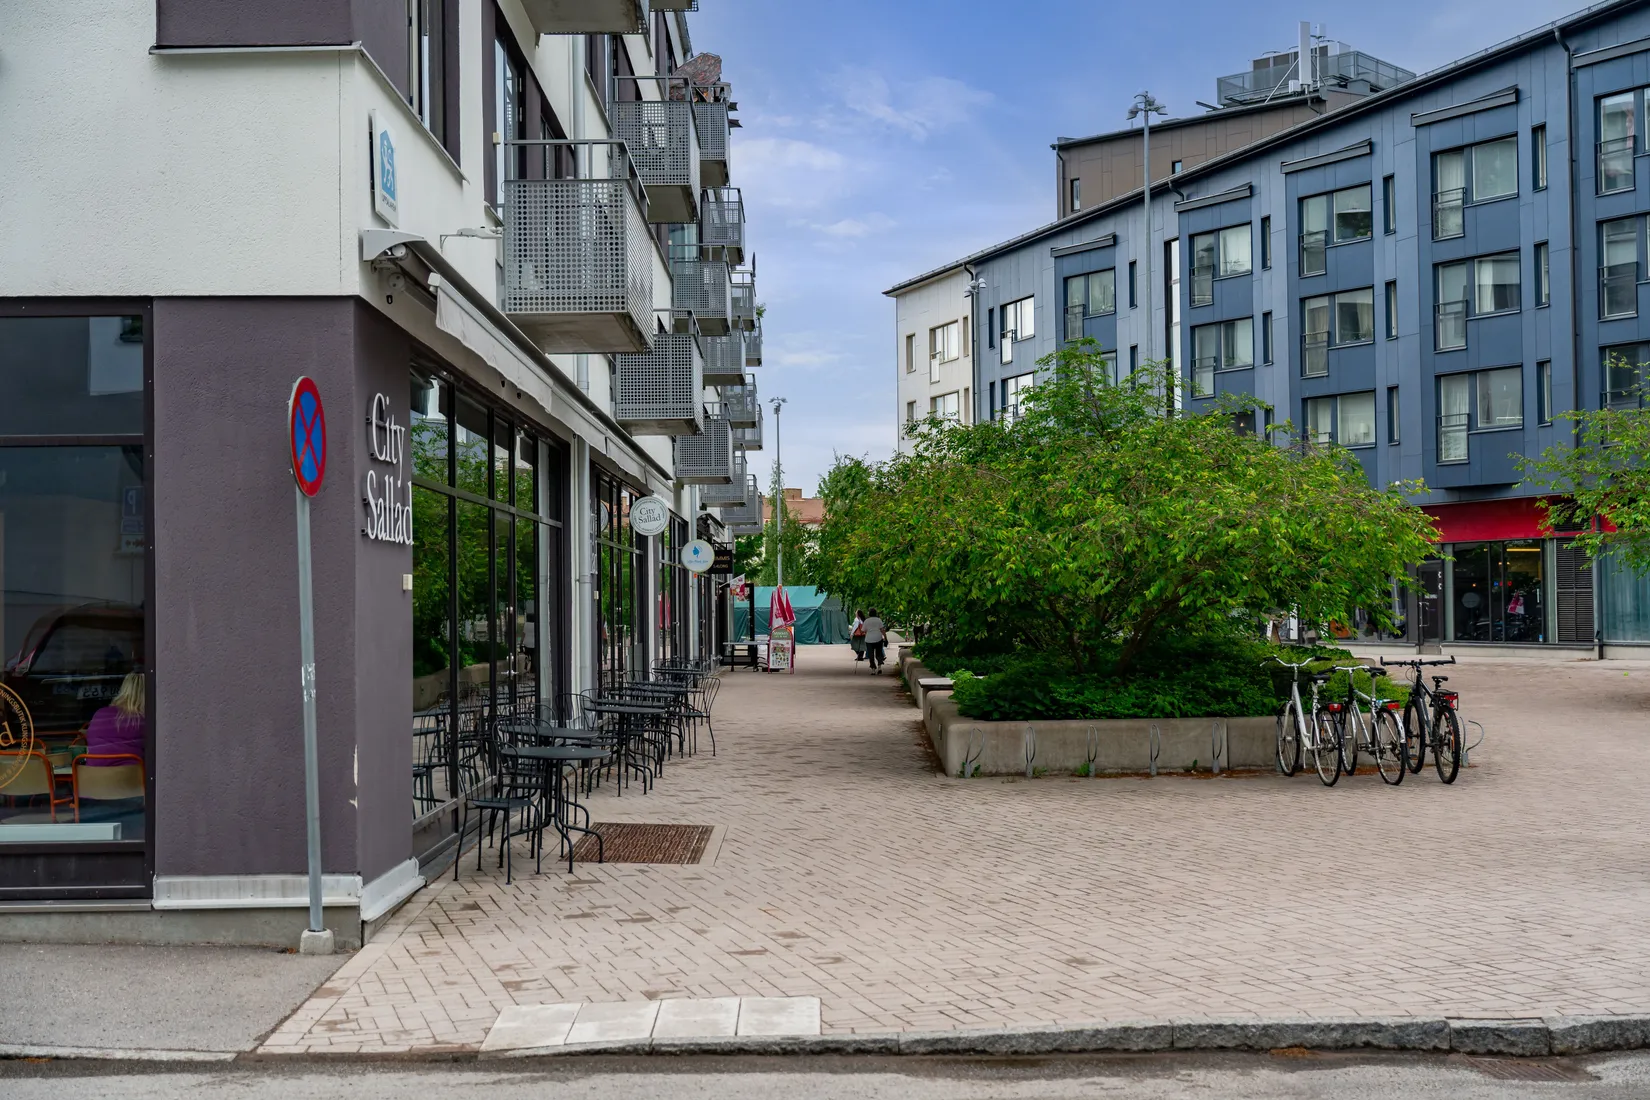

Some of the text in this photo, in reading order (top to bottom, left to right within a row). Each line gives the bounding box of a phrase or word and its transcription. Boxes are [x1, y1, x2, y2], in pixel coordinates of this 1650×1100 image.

[372, 392, 406, 488] City
[367, 469, 414, 546] Sallad
[638, 513, 662, 524] Sallad
[639, 507, 656, 516] City
[0, 688, 27, 723] NINGSBUTIK
